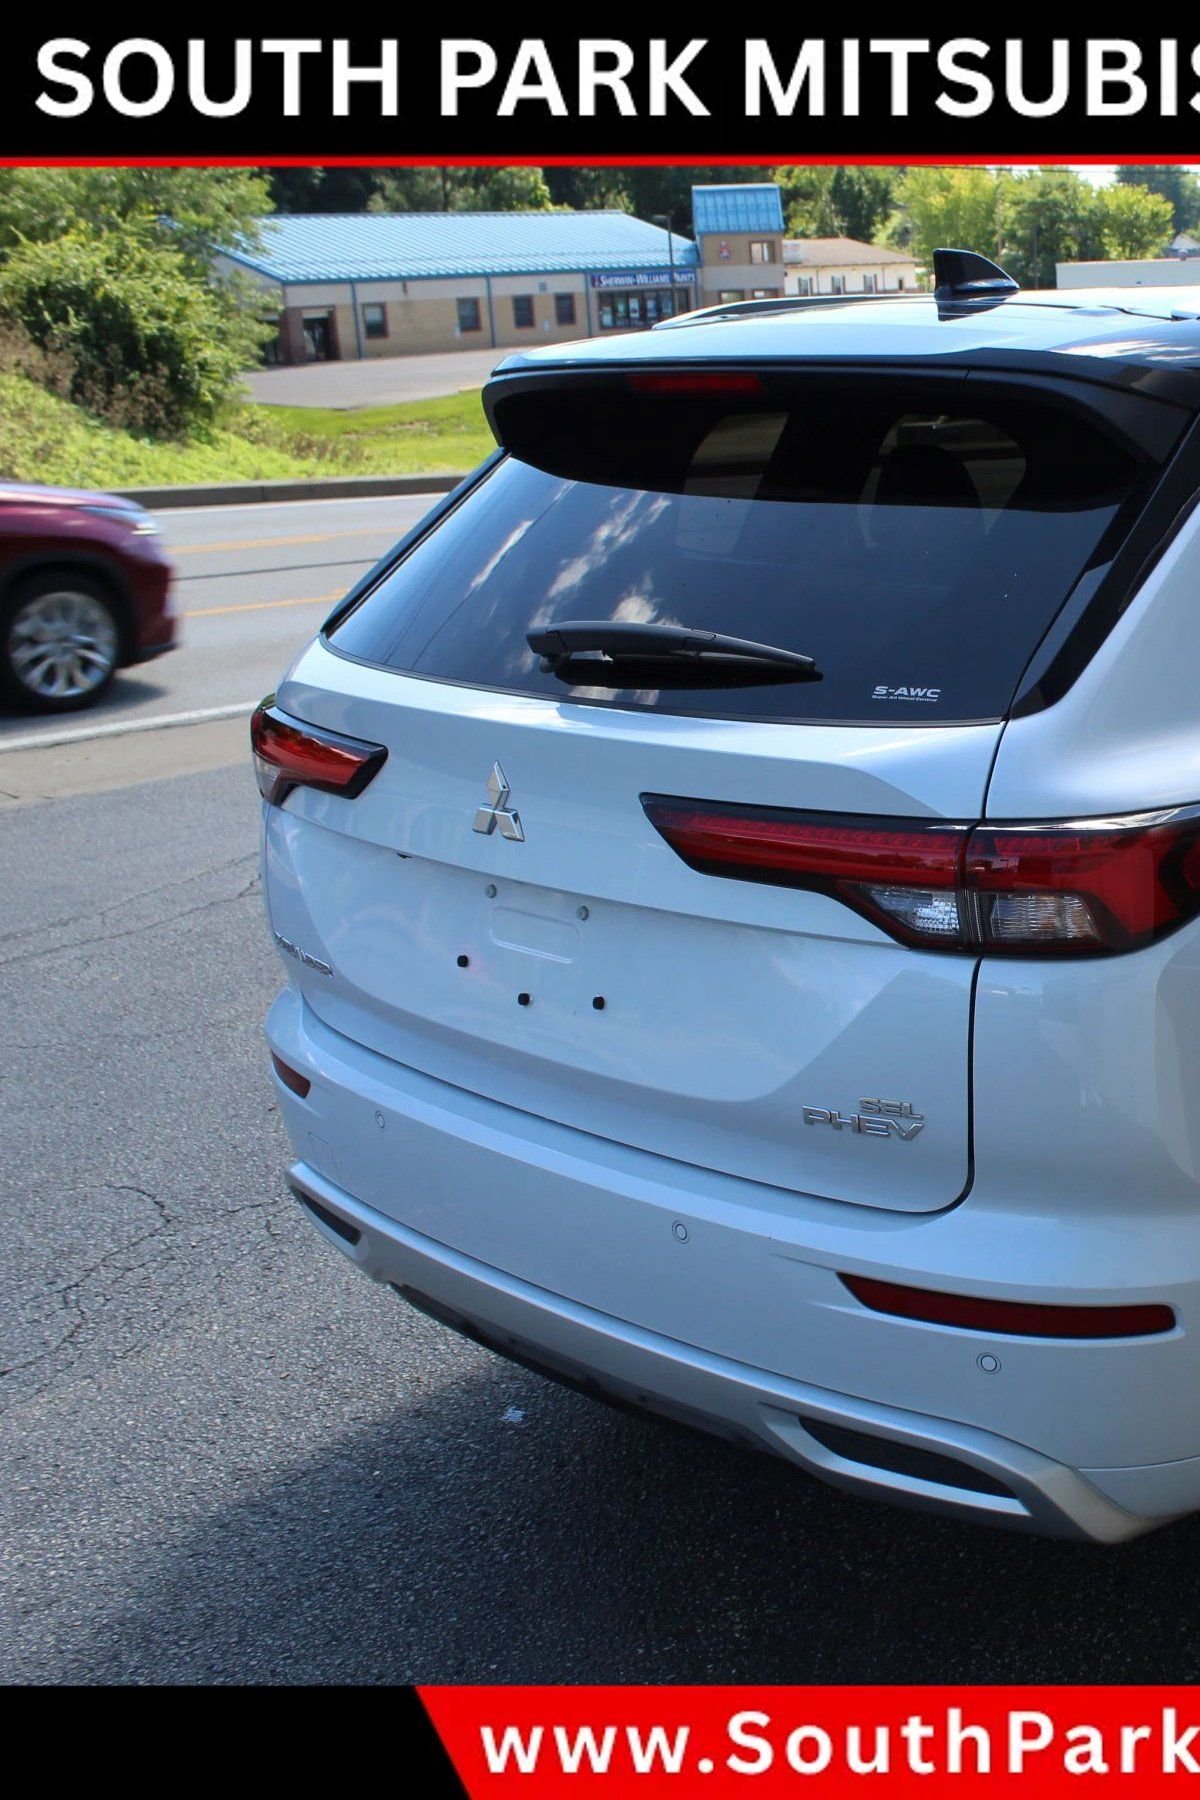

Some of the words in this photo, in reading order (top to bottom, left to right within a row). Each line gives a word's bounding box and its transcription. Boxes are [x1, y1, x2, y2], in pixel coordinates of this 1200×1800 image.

[873, 685, 941, 698] S-AWC
[859, 1097, 924, 1120] SEL
[802, 1105, 924, 1141] PHEV
